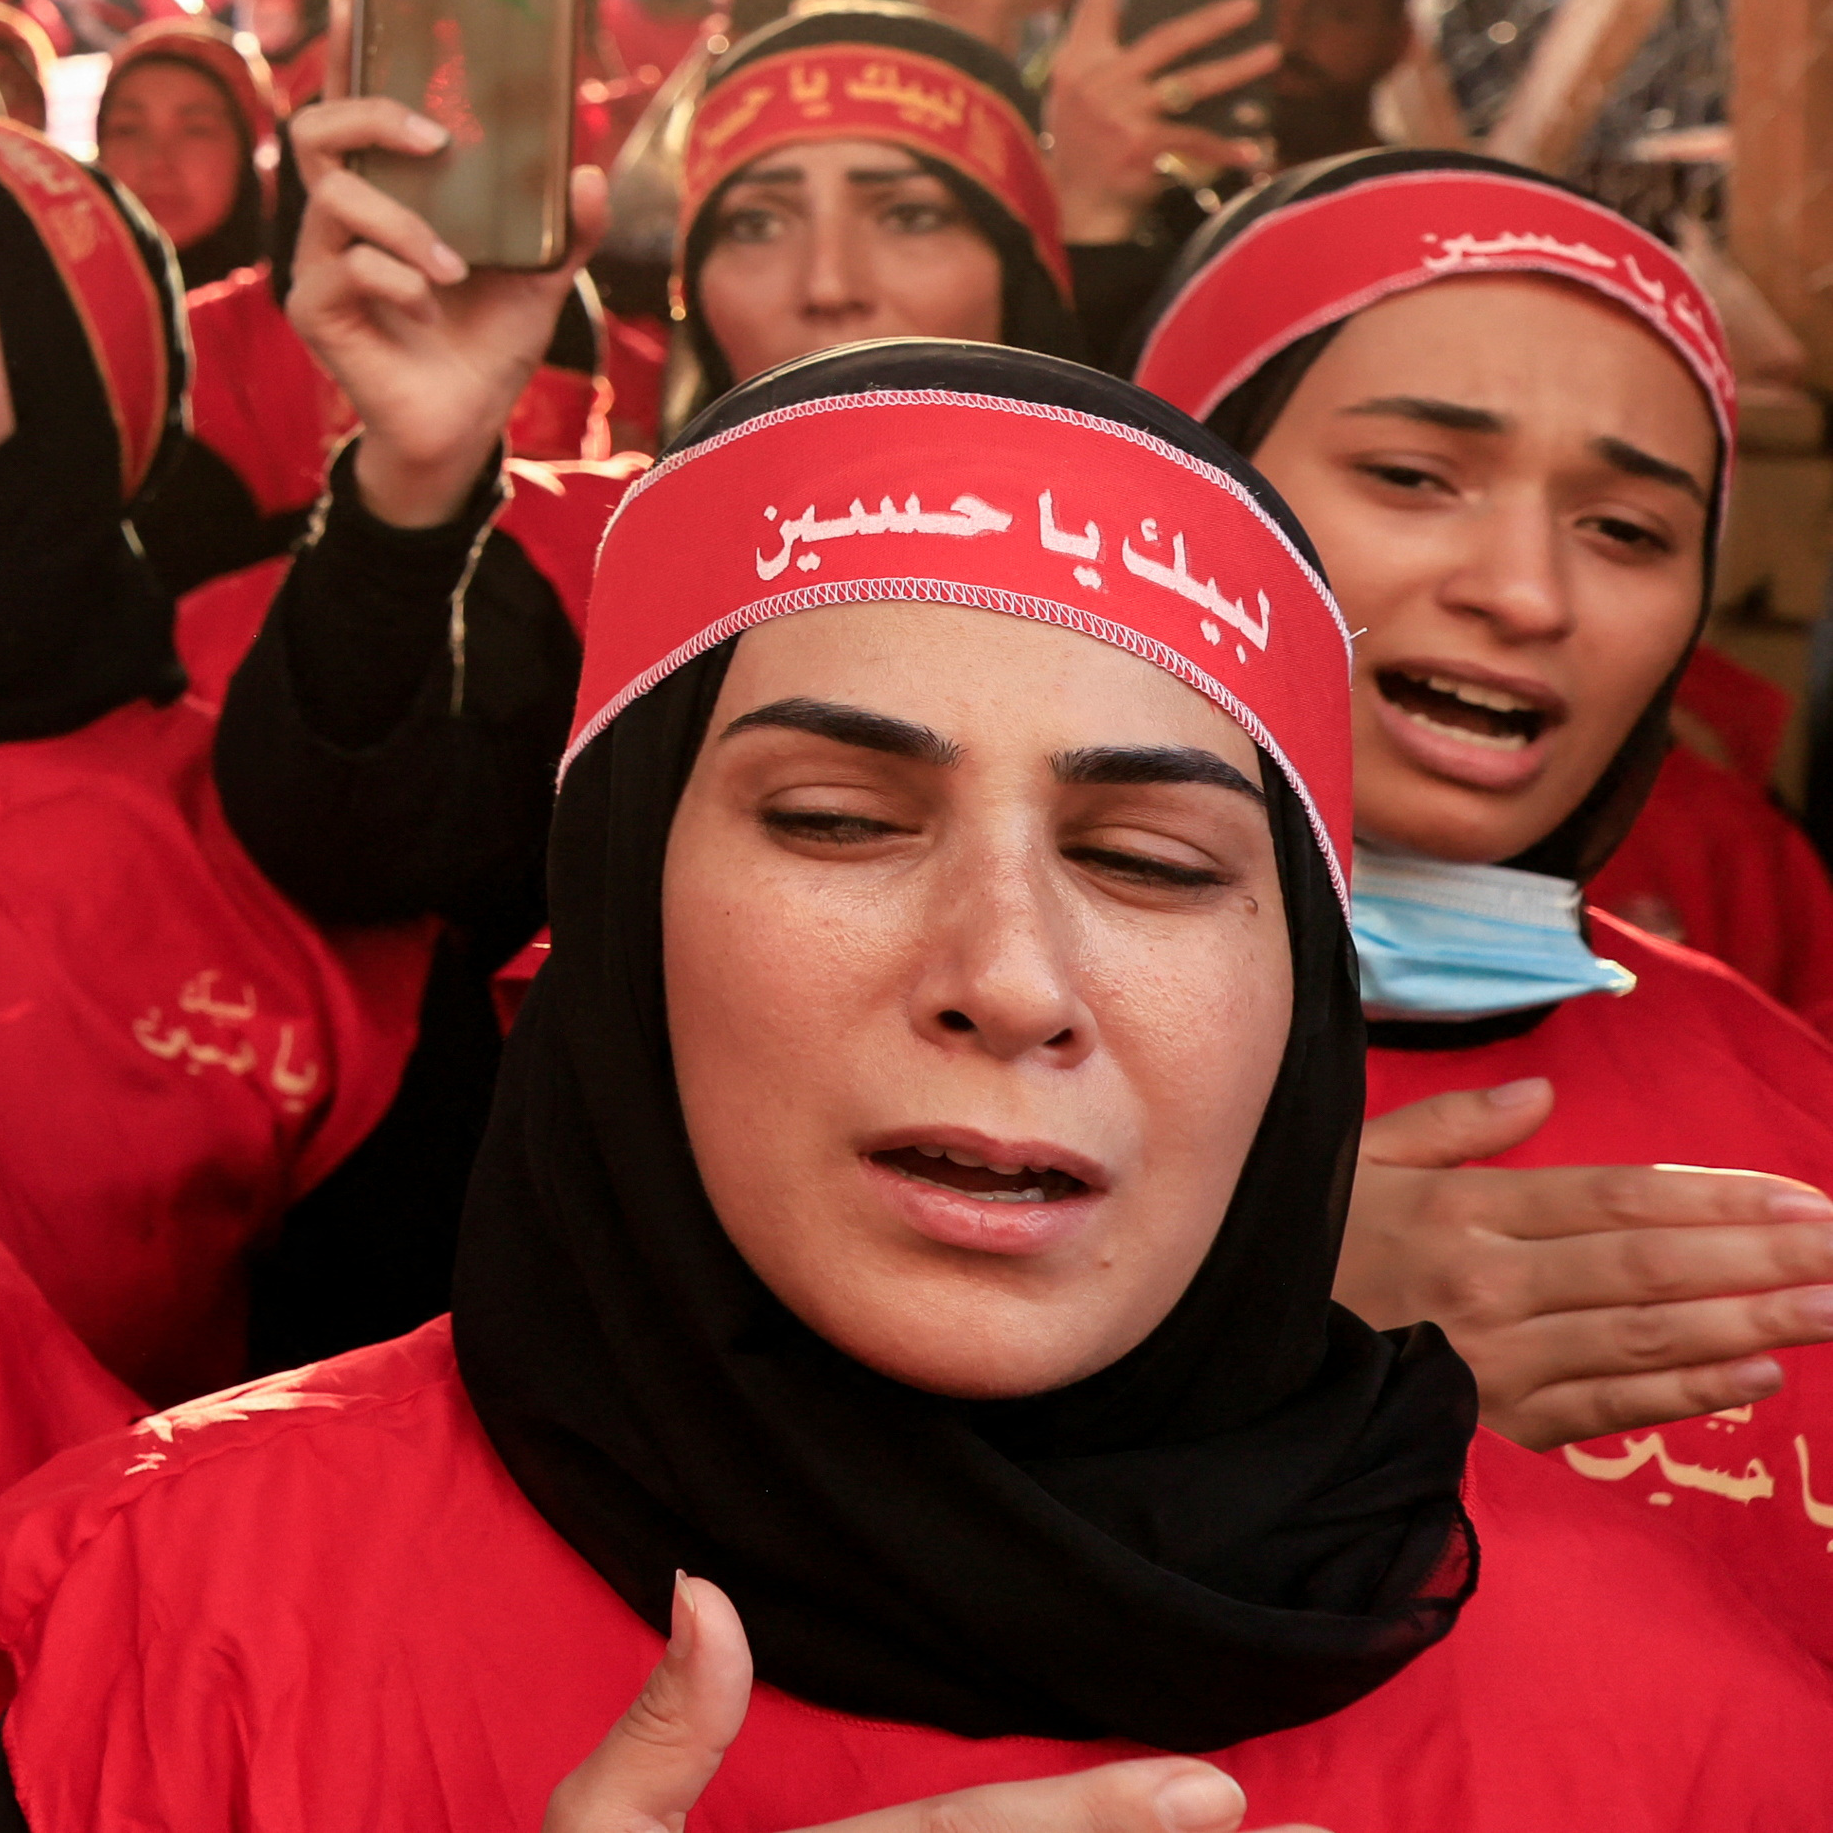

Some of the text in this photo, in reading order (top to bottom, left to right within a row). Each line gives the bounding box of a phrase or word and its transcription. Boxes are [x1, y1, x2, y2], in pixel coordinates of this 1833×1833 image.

[756, 488, 1271, 665] لبيك يا حسين
